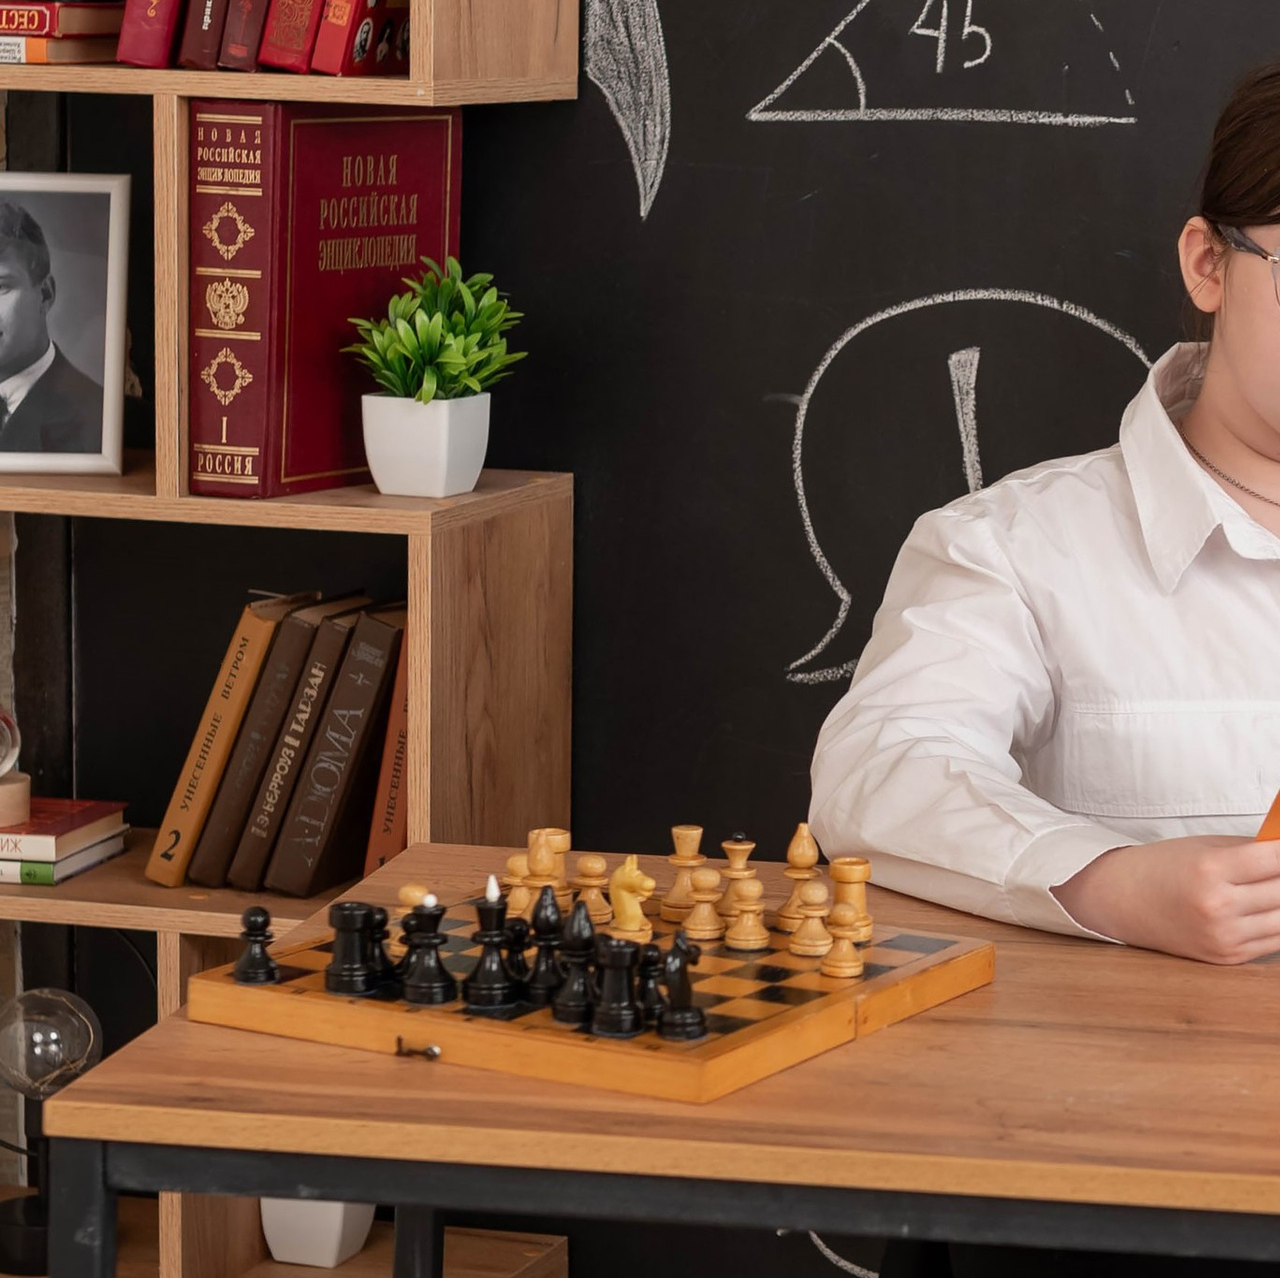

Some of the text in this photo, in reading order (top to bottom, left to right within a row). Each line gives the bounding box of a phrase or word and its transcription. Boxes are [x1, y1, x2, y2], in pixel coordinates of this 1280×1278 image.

[198, 127, 262, 144] НОВАЯ
[197, 147, 262, 165] РОССИЙСКАЯ
[341, 154, 398, 187] НОВАЯ
[197, 167, 262, 185] ЭНЦИКЛОПЕДИЯ
[318, 192, 418, 231] РОССИЙСКАЯ
[318, 234, 417, 274] ЭНЦИКЛОПЕДИЯ
[197, 452, 254, 477] РОССИЯ
[160, 636, 249, 862] 2 УНЕСЕННЫЕ ВЕТРОМ
[383, 728, 407, 834] УНЕСЕННЫЕ
